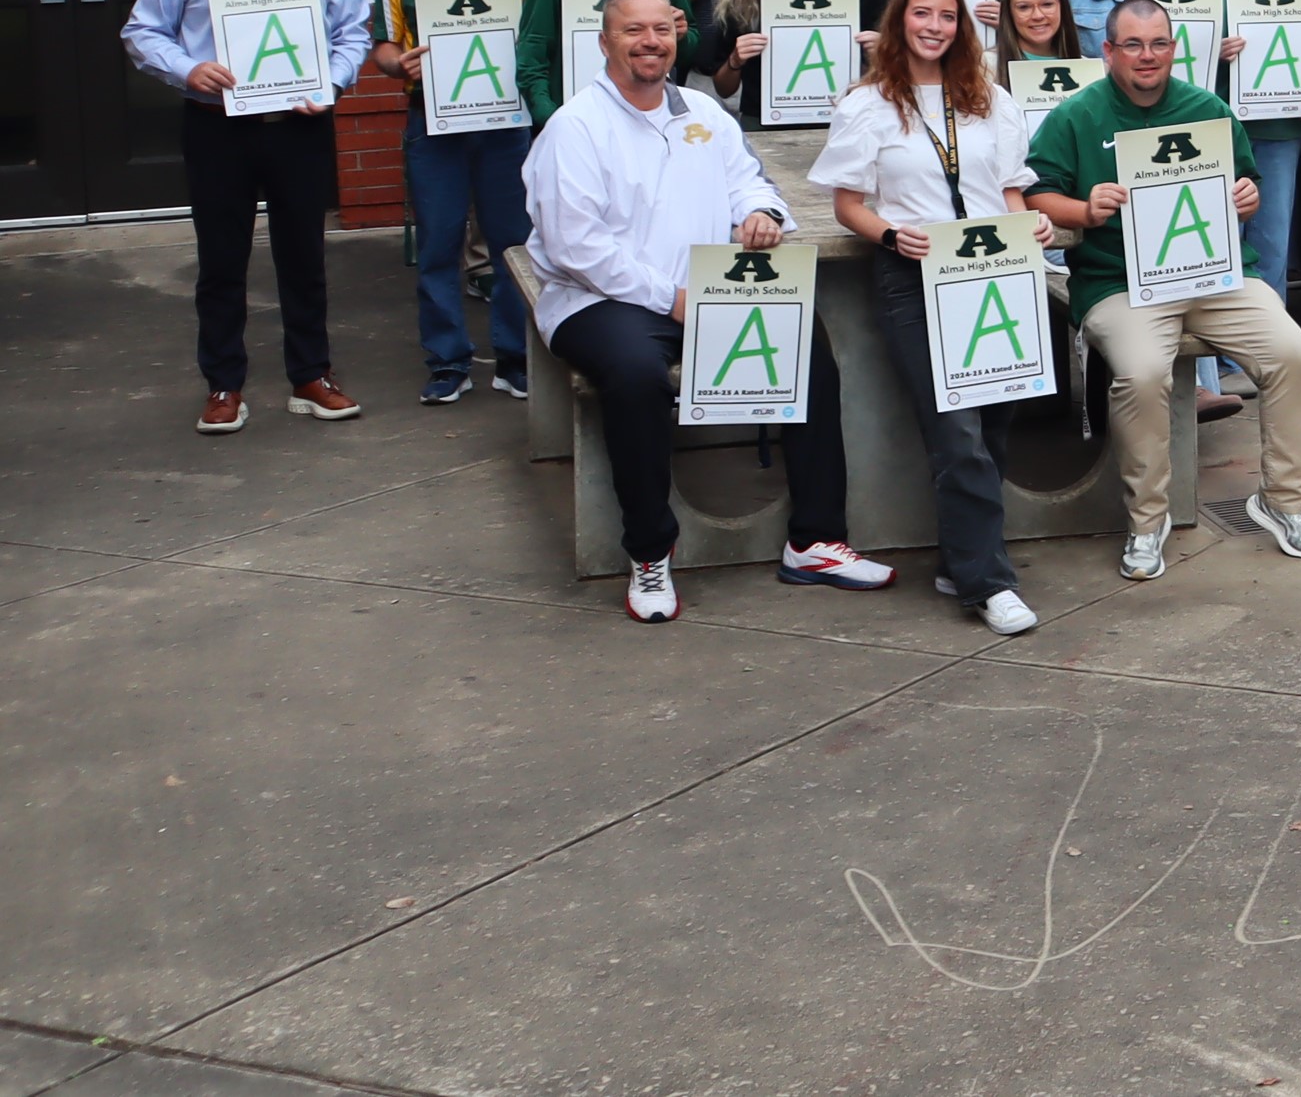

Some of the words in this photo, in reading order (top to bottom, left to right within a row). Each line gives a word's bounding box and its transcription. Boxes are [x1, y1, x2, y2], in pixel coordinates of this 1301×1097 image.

[457, 18, 477, 27] High
[479, 16, 508, 24] School
[798, 13, 817, 21] High
[1263, 9, 1281, 17] High
[247, 13, 304, 82] A
[785, 29, 836, 93] A
[1252, 25, 1300, 89] A
[450, 34, 504, 102] A
[1151, 131, 1200, 163] A
[1135, 171, 1159, 179] Alma
[1162, 166, 1185, 176] High
[1188, 160, 1219, 172] School
[956, 224, 1007, 258] A
[1155, 184, 1214, 267] A
[724, 251, 779, 282] A
[939, 265, 965, 274] Alma
[968, 260, 991, 271] High
[994, 255, 1027, 267] School
[1143, 268, 1174, 278] 2024-25
[1182, 262, 1203, 271] Rated
[1204, 258, 1228, 267] School
[703, 286, 731, 294] Alma
[734, 286, 759, 296] High
[762, 286, 797, 294] School
[962, 280, 1024, 368] A
[712, 306, 778, 387] A
[949, 369, 982, 380] 2024-25
[991, 365, 1013, 373] Rated
[1014, 360, 1039, 370] School
